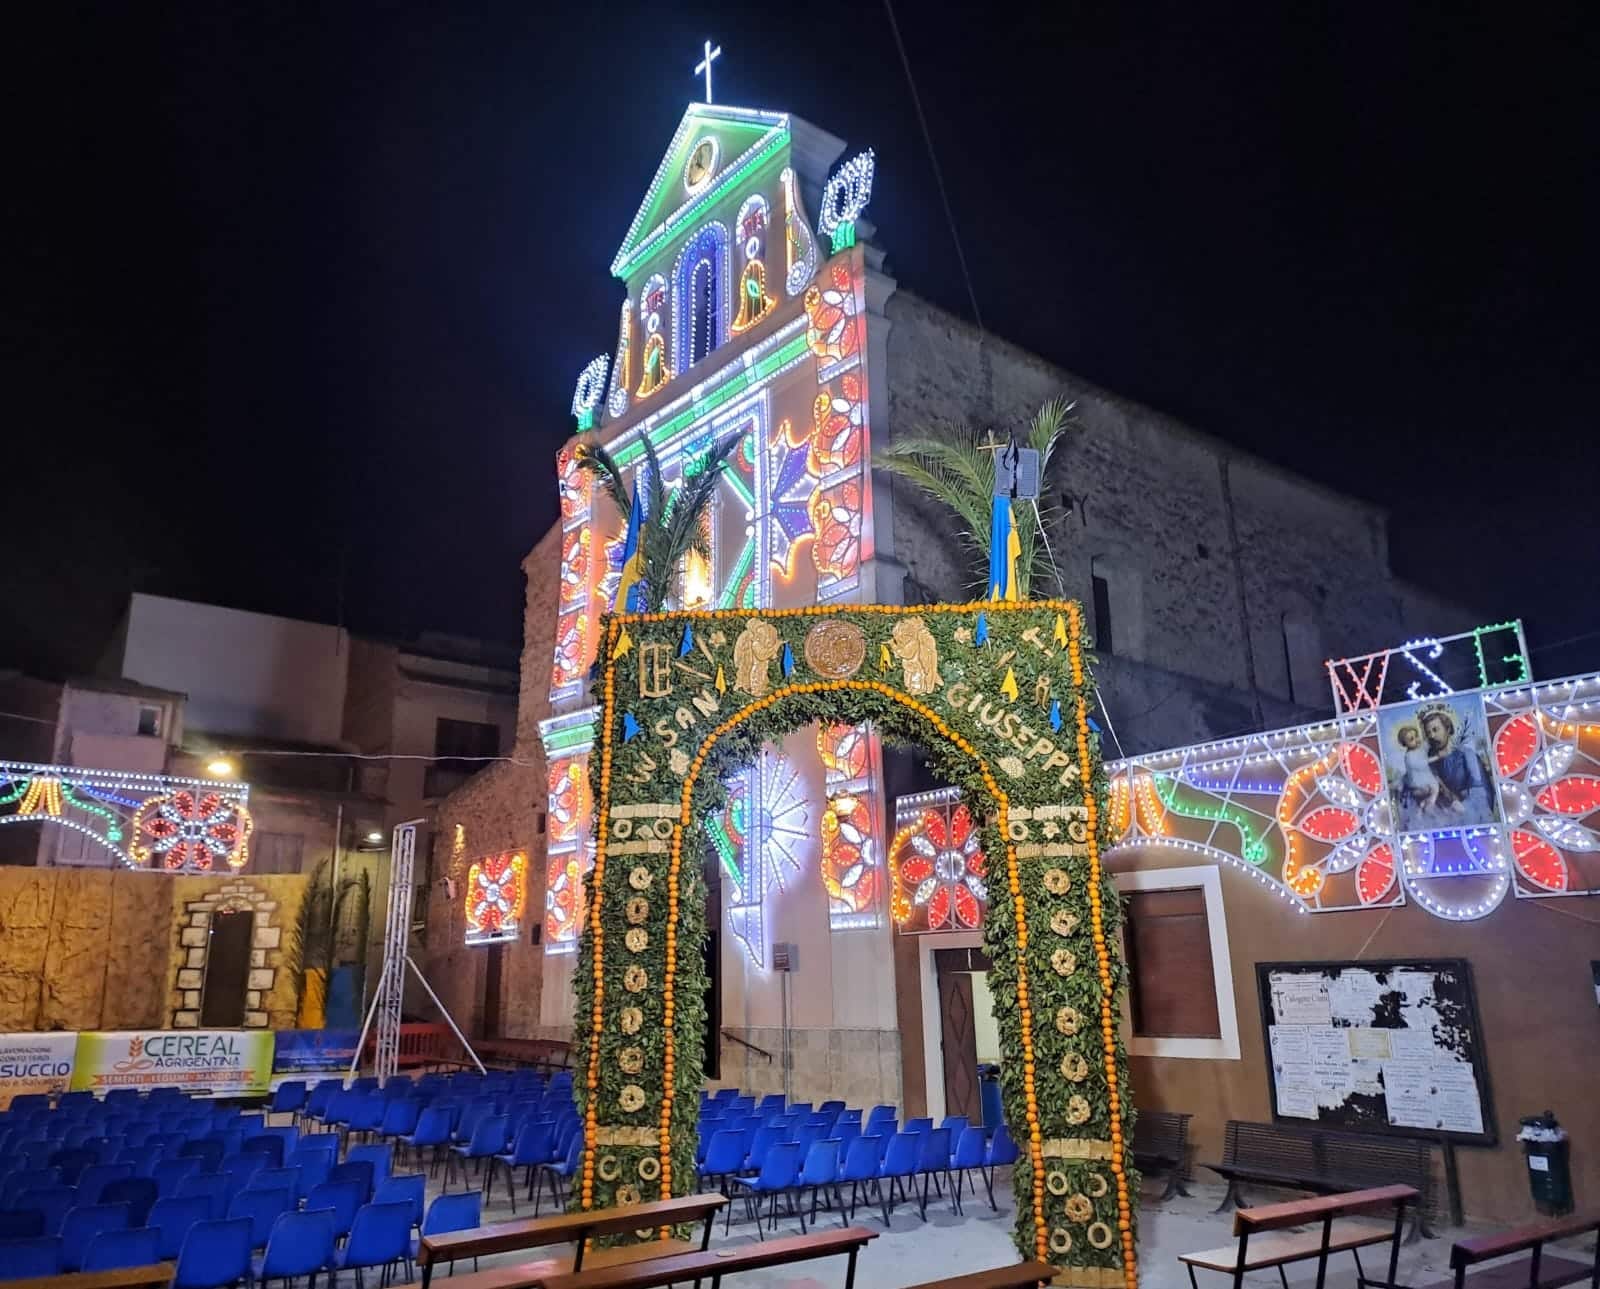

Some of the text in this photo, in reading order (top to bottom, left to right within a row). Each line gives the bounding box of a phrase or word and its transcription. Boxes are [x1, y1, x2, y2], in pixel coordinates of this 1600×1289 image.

[655, 688, 720, 748] SAN
[946, 682, 1082, 788] GIUSEPPE
[143, 1035, 241, 1057] CEREAL
[154, 1056, 240, 1068] AGRIGENTINA
